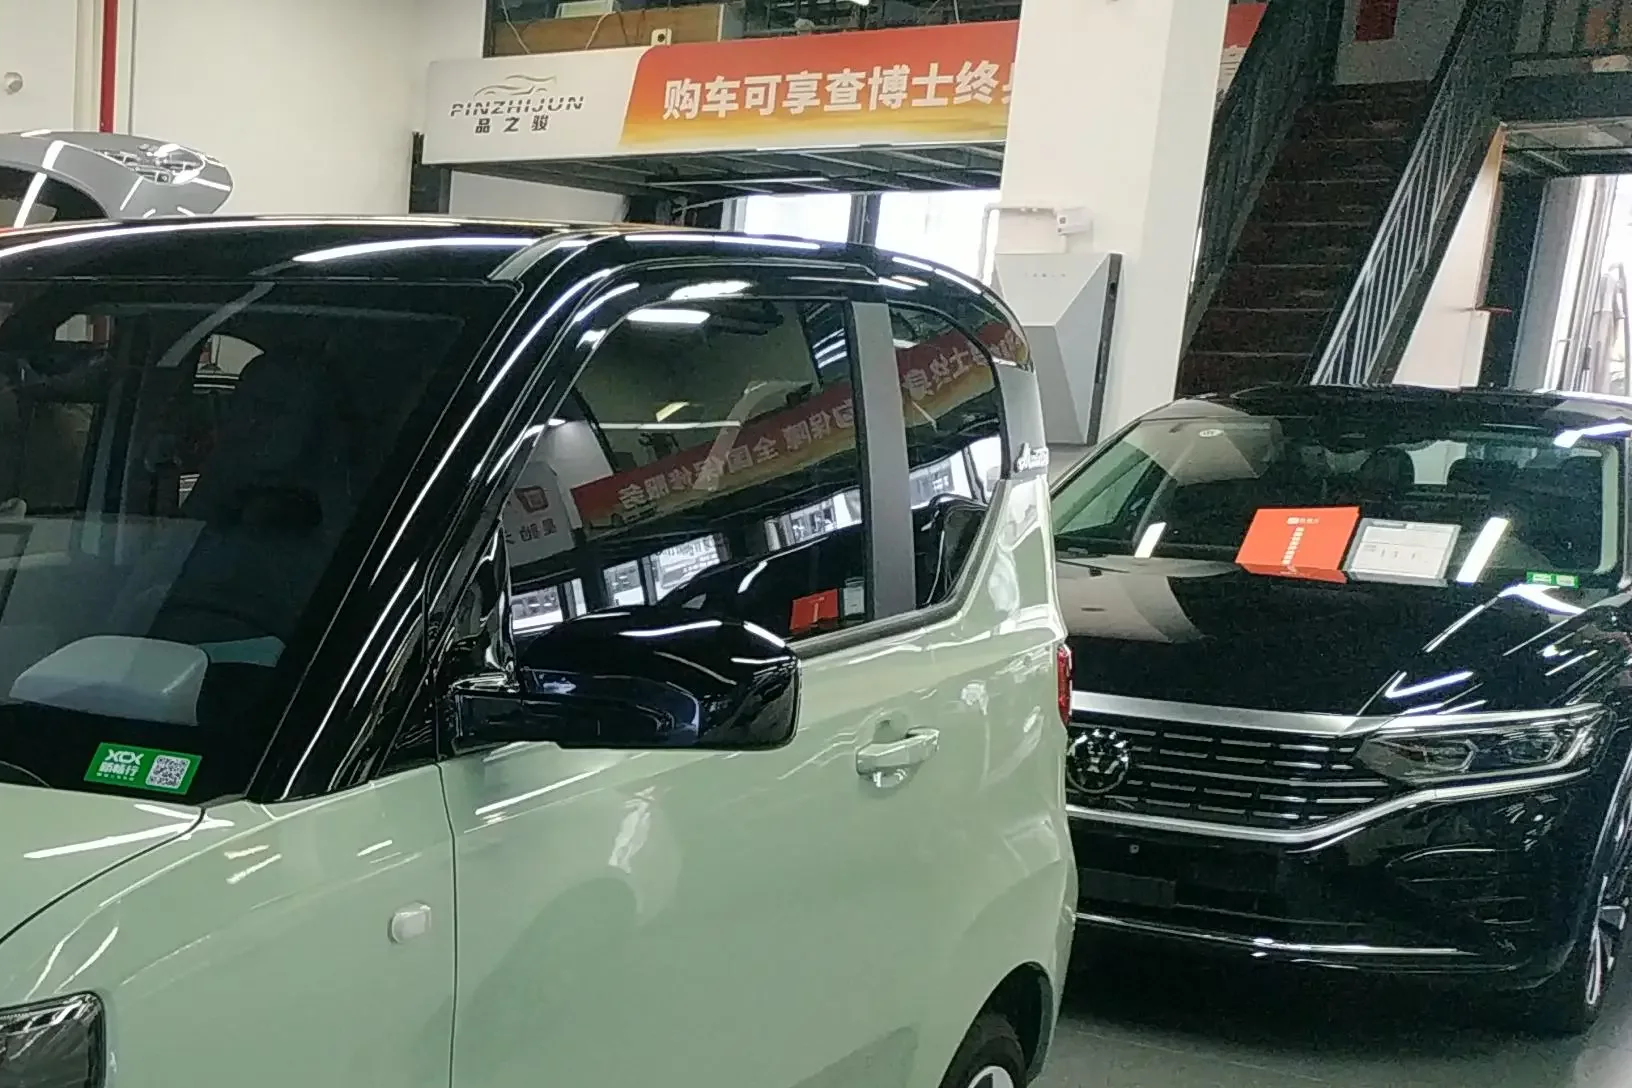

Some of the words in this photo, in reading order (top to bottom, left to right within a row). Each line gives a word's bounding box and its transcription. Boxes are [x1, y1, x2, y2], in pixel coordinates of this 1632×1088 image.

[450, 96, 584, 117] PINZHIJUN
[474, 114, 549, 134] 品之骏
